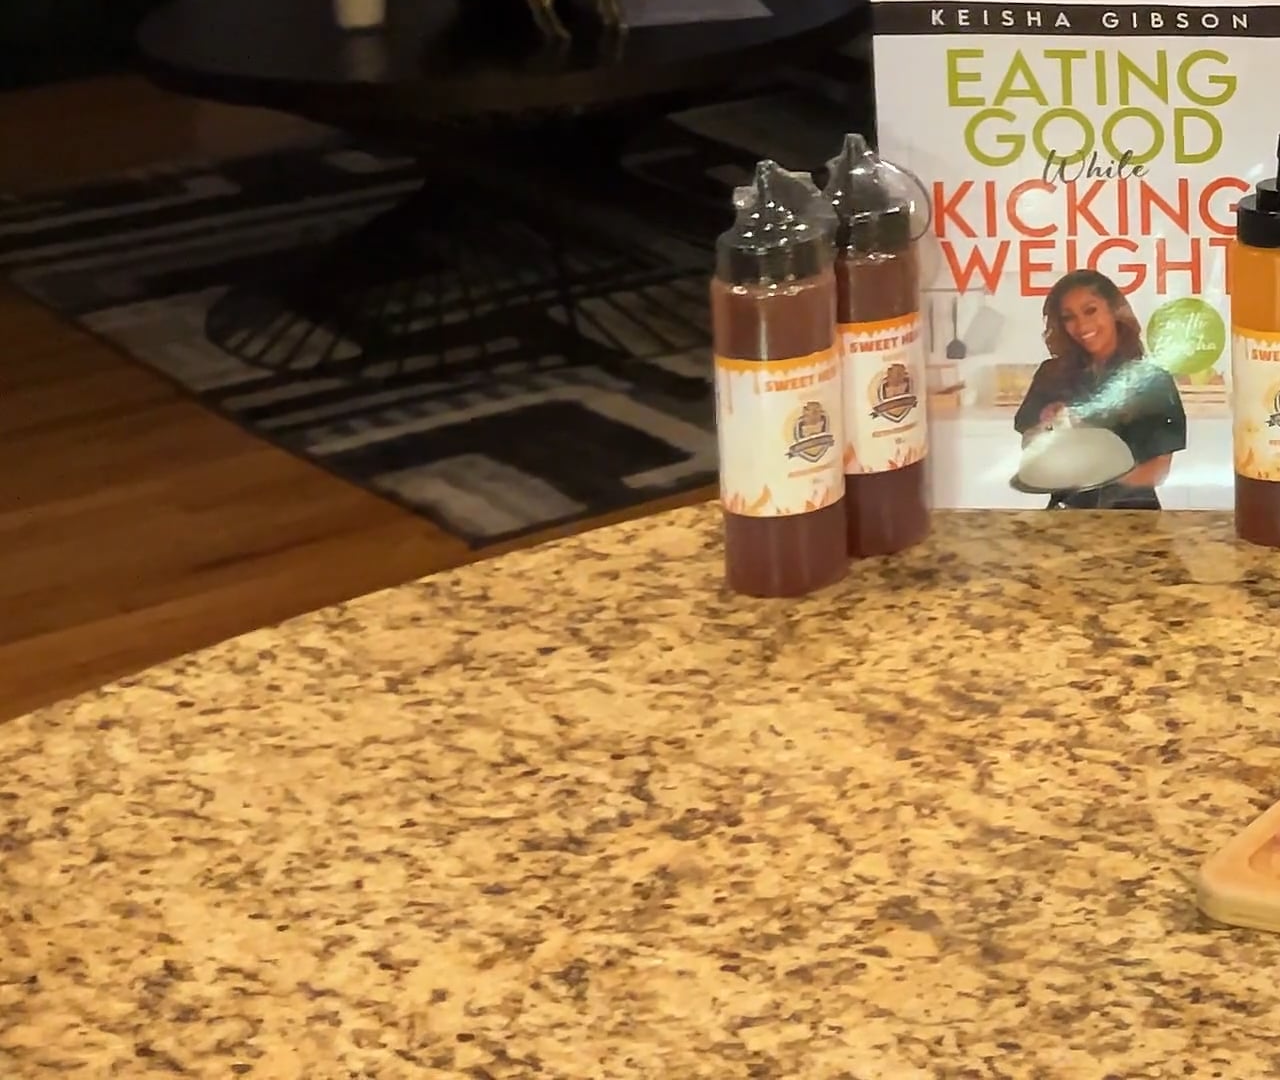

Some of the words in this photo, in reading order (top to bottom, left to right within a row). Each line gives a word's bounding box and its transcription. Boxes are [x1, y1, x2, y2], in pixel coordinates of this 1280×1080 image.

[930, 8, 1071, 29] KEISHA
[1101, 12, 1249, 30] GIBSON
[947, 49, 1237, 106] EATING
[964, 106, 1223, 167] GOOD
[1042, 149, 1150, 185] While
[933, 176, 1251, 238] KICKING
